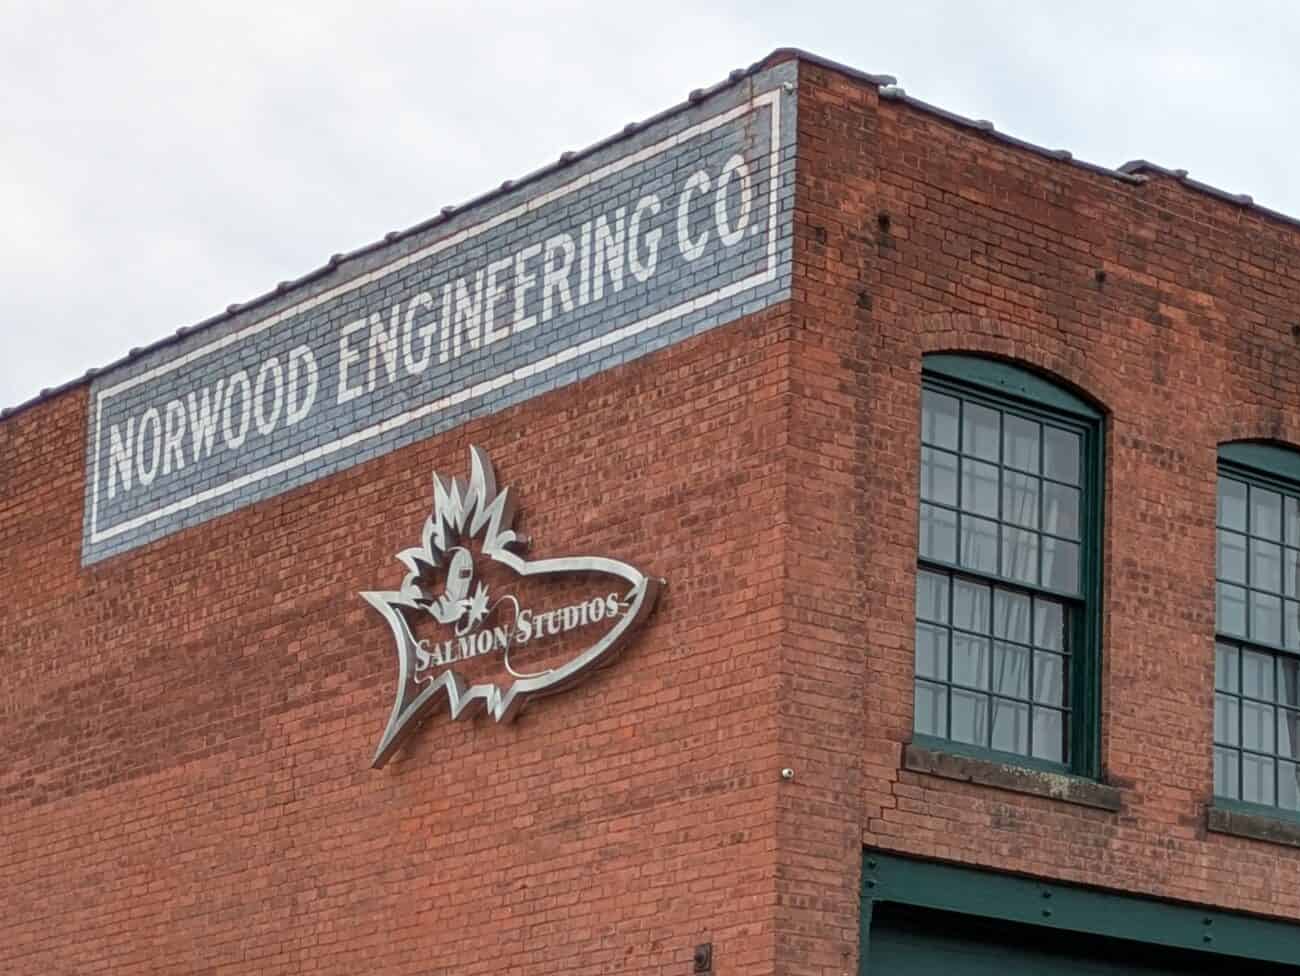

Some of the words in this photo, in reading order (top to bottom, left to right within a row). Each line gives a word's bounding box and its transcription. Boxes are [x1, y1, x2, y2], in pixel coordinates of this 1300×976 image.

[107, 344, 319, 500] NORWOOD
[336, 194, 663, 405] ENGINEERING
[676, 152, 759, 262] CO.
[414, 623, 510, 673] SALMON
[515, 591, 620, 644] STUDIOS
